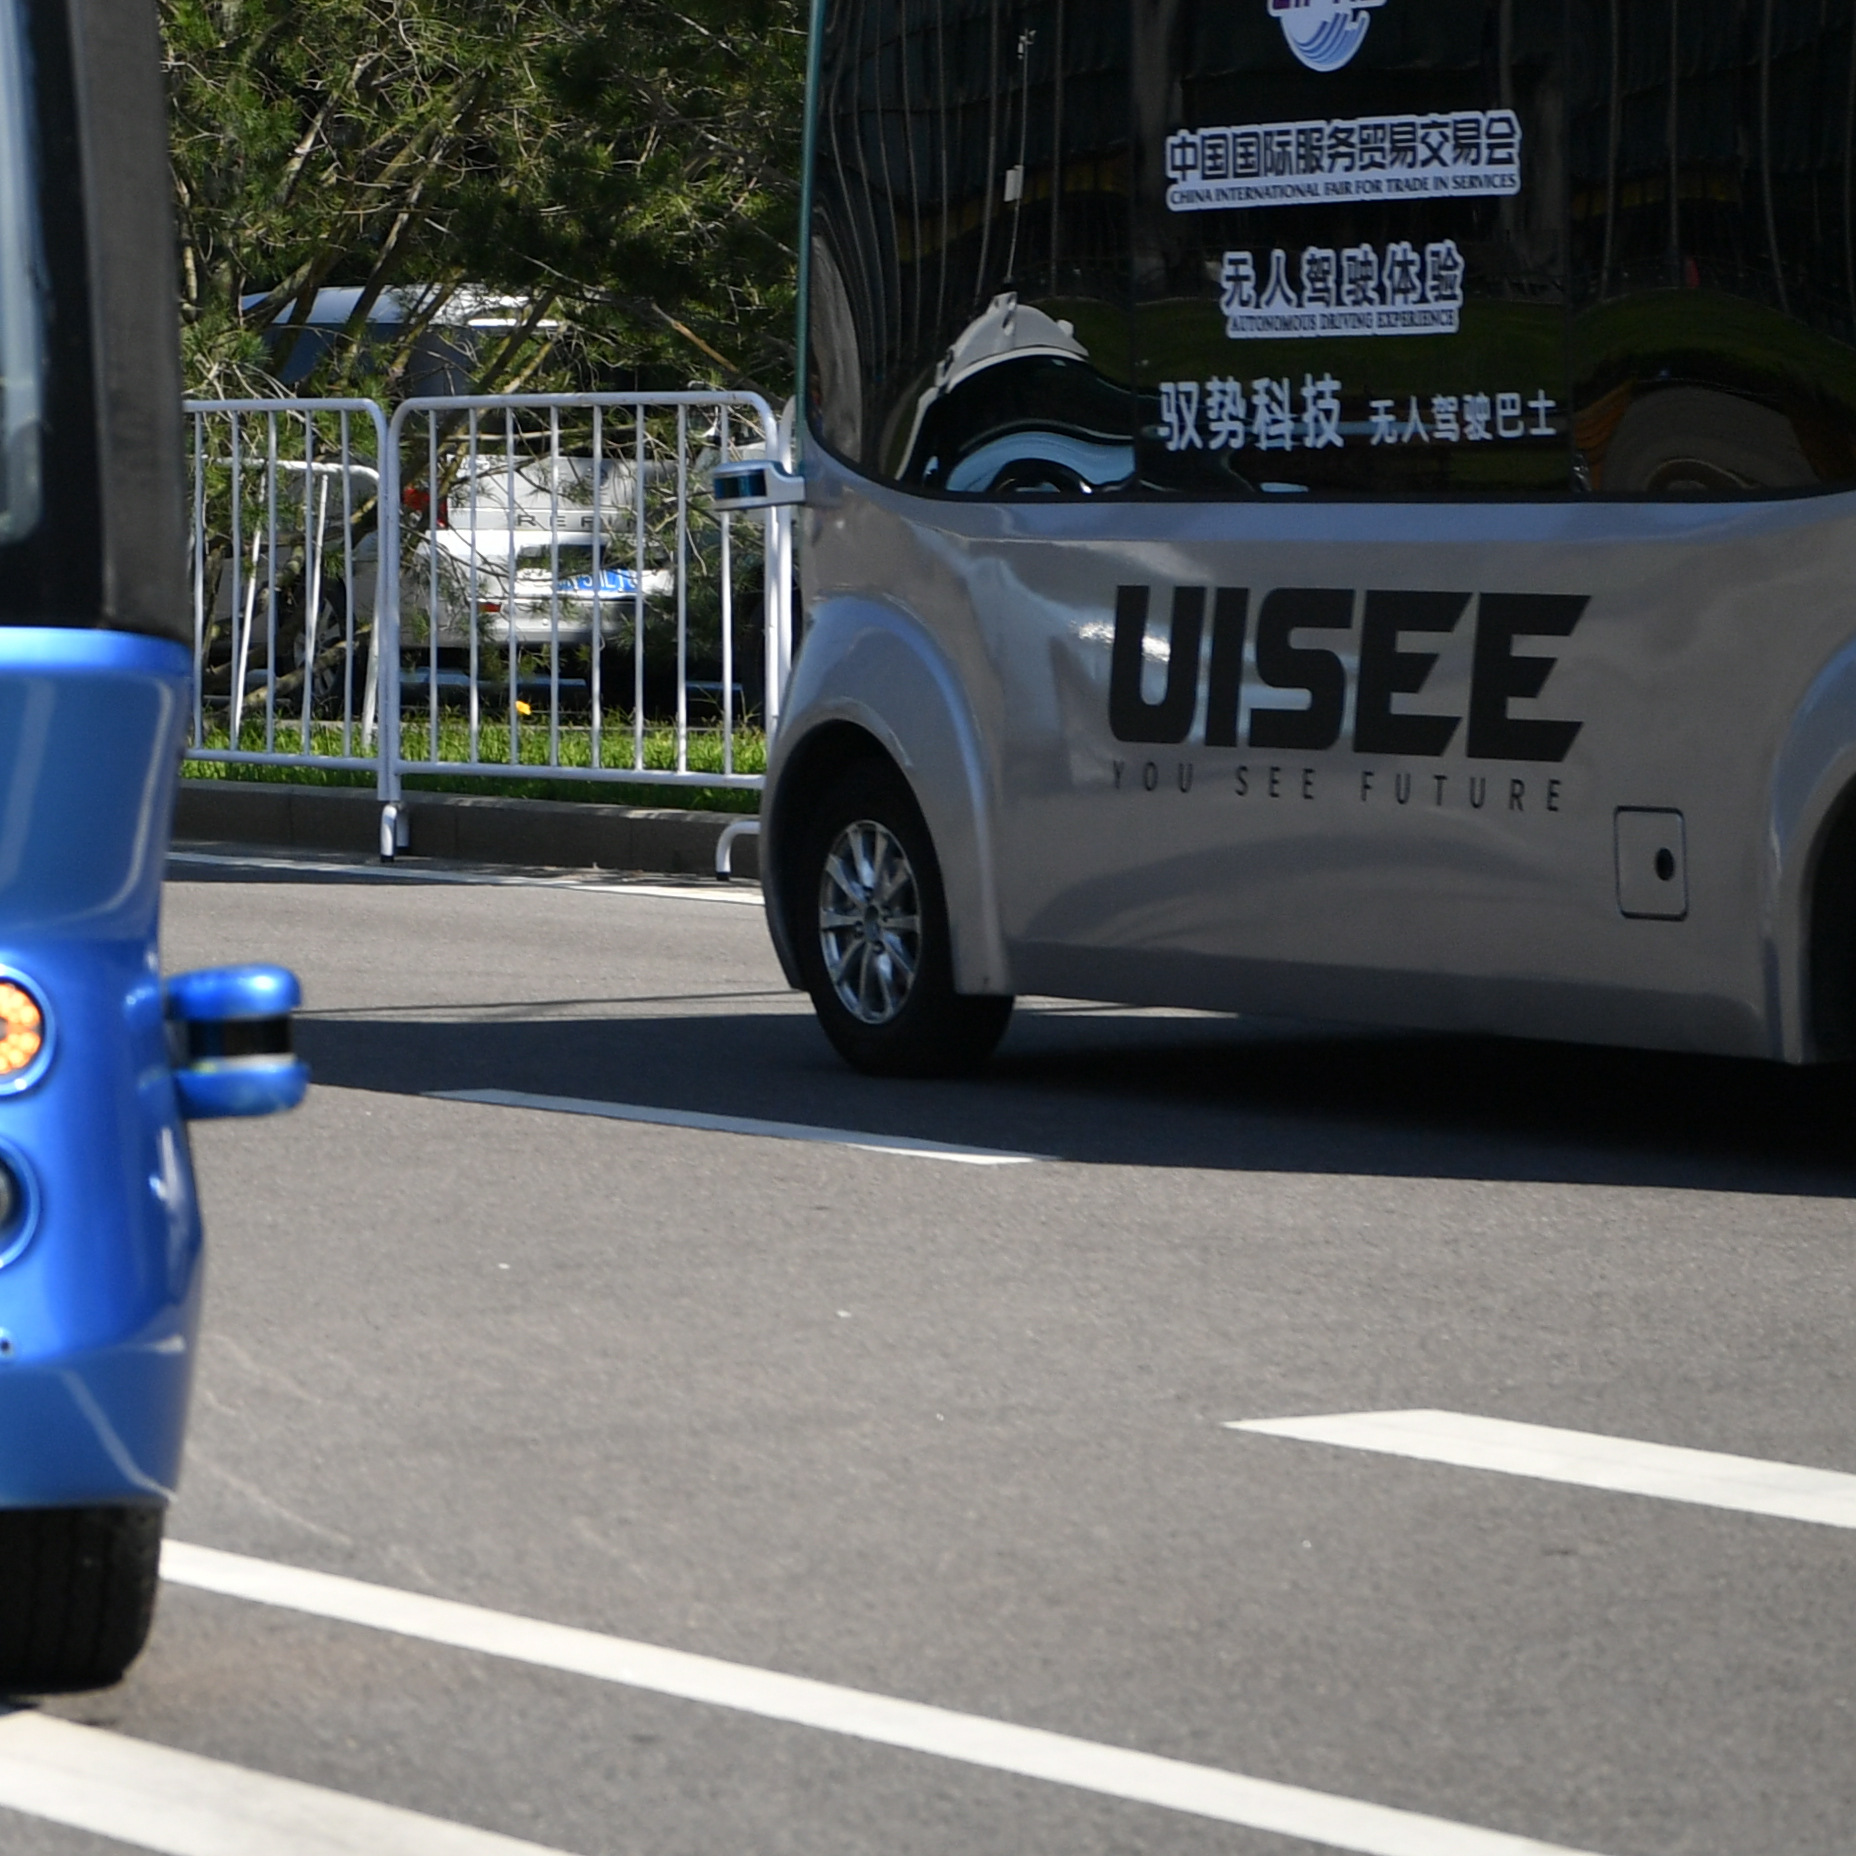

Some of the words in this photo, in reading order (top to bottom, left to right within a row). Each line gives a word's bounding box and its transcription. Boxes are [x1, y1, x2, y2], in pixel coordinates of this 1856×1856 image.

[1169, 115, 1517, 182] 中国国际服务贸易交易会
[1170, 190, 1213, 205] CHINA
[1215, 183, 1321, 203] INTERNATIONAL
[1324, 180, 1353, 196] FAIR
[1355, 178, 1383, 195] FOR
[1387, 176, 1430, 193] TRADE
[1433, 175, 1450, 191] IN
[1452, 172, 1517, 191] SERVICES
[1224, 246, 1461, 309] 无人驾驶体验
[1230, 313, 1317, 332] AUTONOMOUS
[1319, 311, 1373, 330] DRIVING
[1377, 309, 1456, 329] EXPERIENCE
[1157, 373, 1345, 451] 驭势科技
[1368, 388, 1557, 446] 无人驾驶巴士
[1108, 585, 1592, 763] UISEE
[1113, 760, 1194, 794] YOU
[1236, 765, 1316, 801] SEE
[1360, 770, 1563, 813] FUTURE
